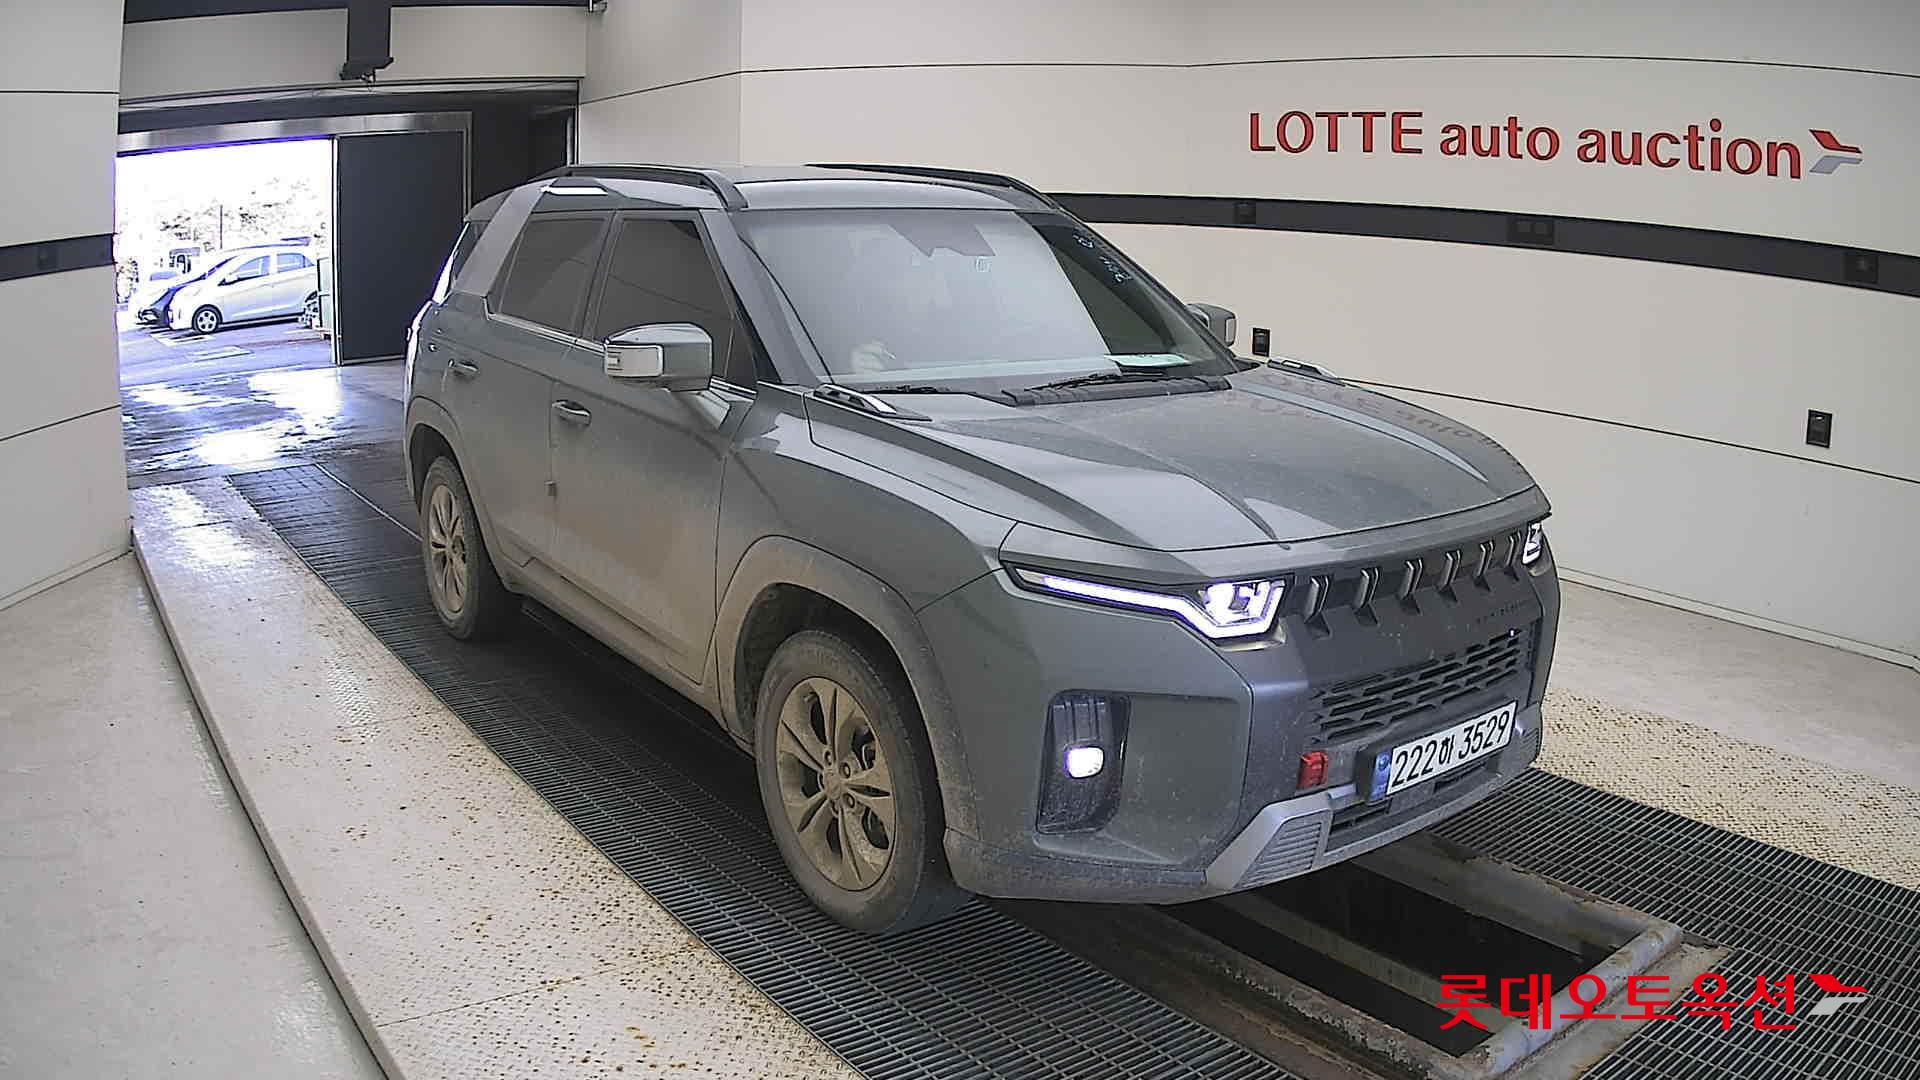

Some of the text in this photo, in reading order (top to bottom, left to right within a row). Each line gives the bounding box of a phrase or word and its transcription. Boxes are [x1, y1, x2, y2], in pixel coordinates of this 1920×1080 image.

[1248, 110, 1802, 180] LOTTE auto auction
[1458, 710, 1510, 760] 3529
